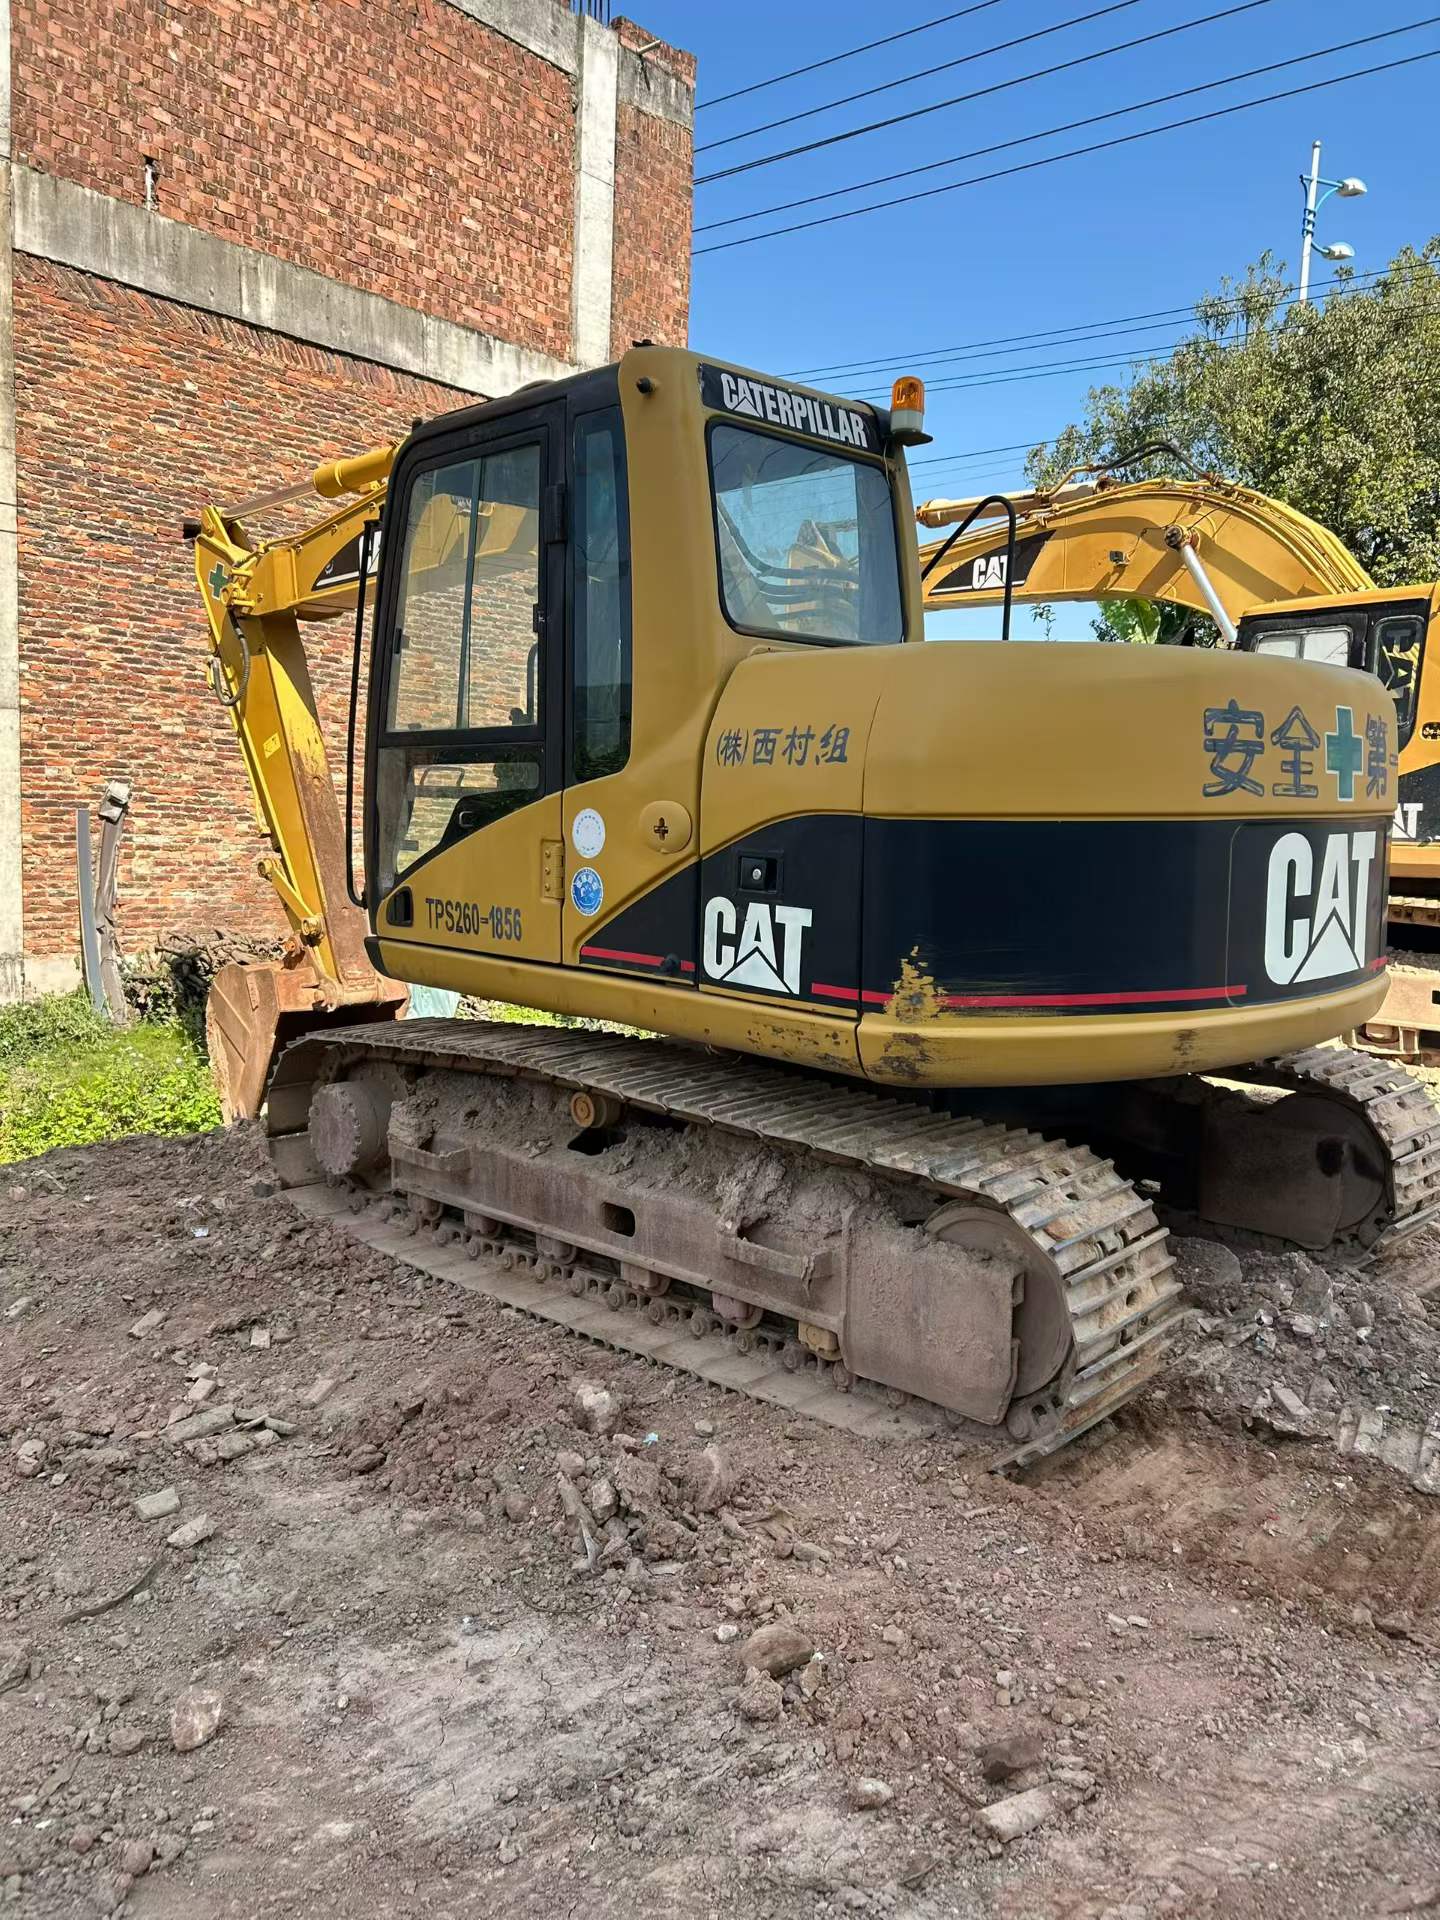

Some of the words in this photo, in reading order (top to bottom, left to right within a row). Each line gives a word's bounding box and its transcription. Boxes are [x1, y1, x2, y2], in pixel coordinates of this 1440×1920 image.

[720, 373, 868, 448] CATERPILLAR
[1203, 699, 1320, 798] 安全
[425, 897, 522, 941] TPS260-1856
[703, 896, 813, 995] CAT
[1264, 831, 1377, 985] CAT
